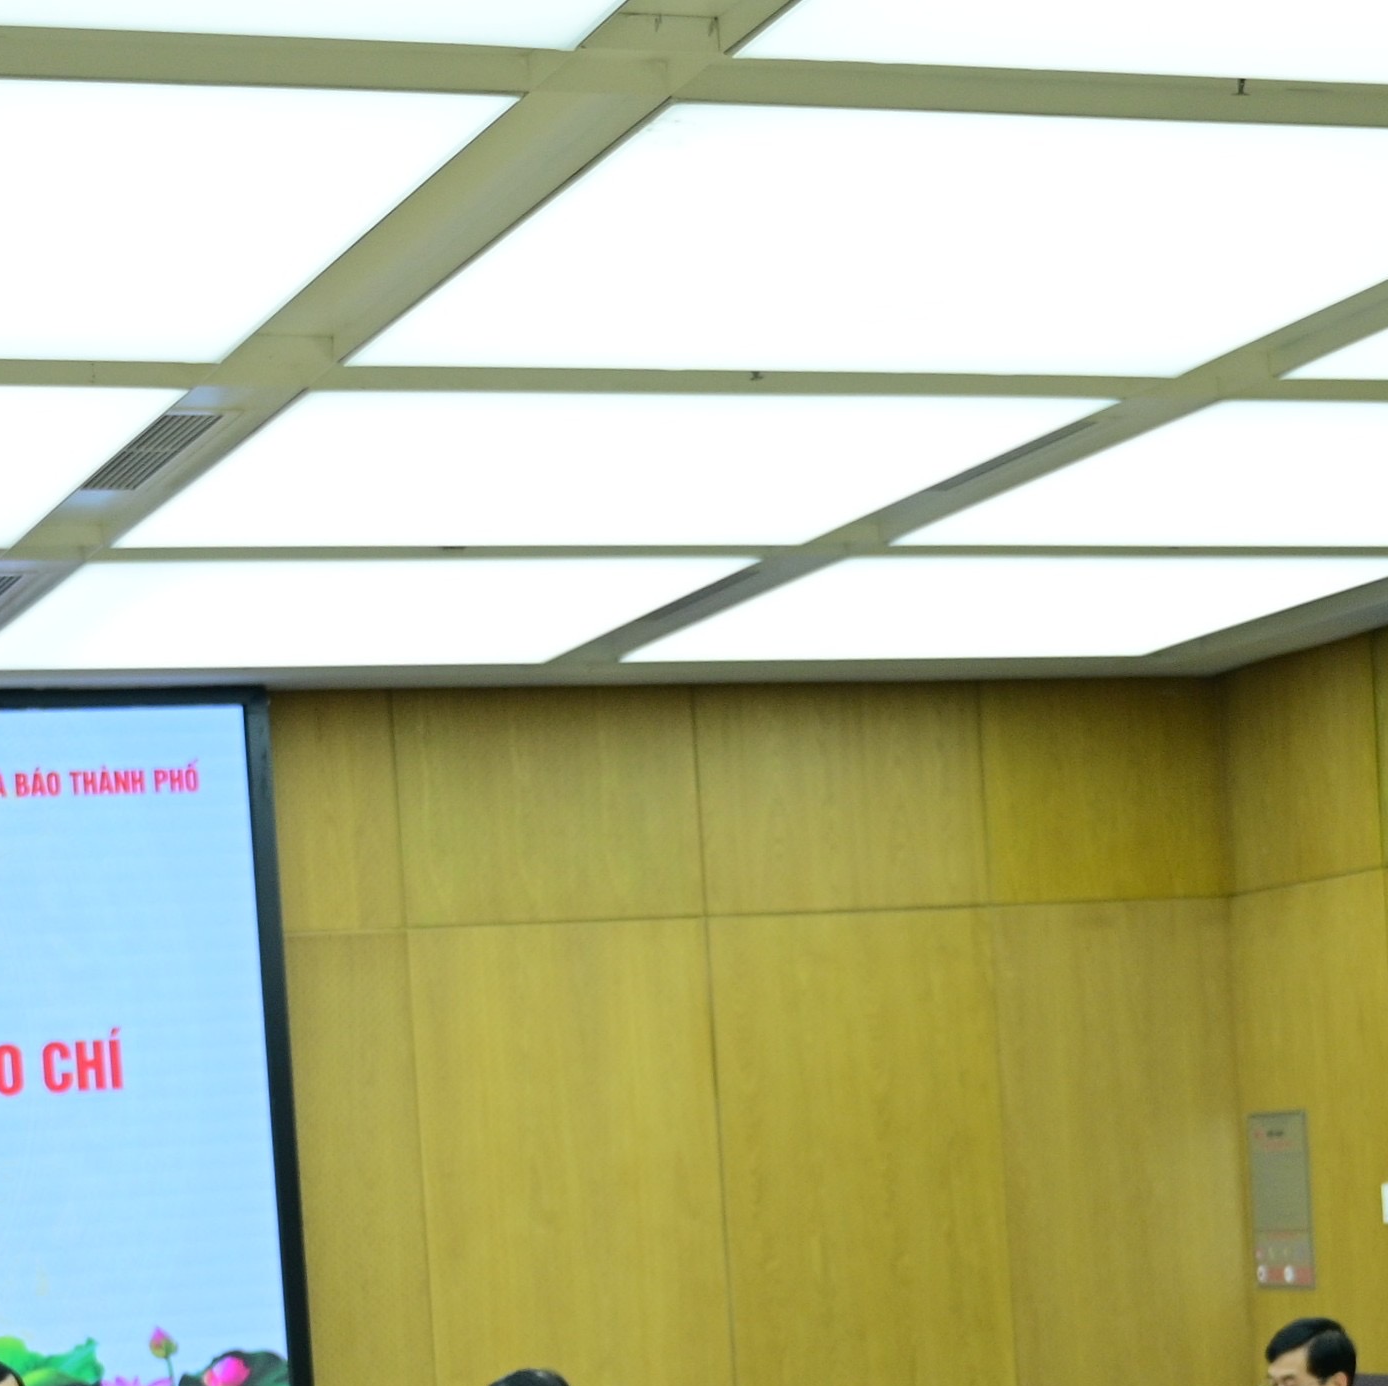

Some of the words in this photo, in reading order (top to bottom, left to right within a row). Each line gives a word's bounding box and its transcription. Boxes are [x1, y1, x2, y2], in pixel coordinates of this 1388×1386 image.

[14, 766, 62, 798] BÁO
[70, 765, 146, 796] THÀNH
[154, 757, 200, 793] PHỐ
[41, 1026, 124, 1095] CHÍ
